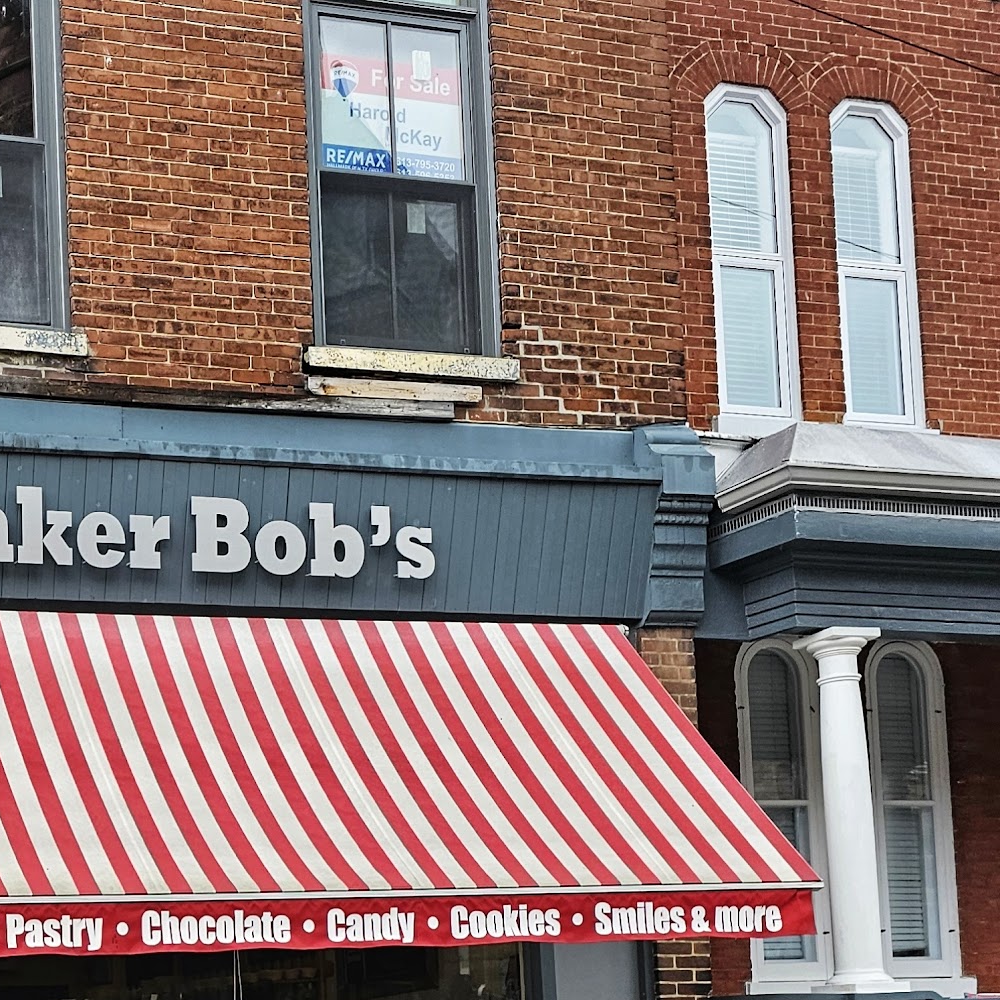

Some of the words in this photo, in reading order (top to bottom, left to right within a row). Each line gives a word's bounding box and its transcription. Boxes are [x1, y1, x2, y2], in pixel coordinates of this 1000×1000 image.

[349, 101, 406, 123] Harod
[326, 147, 386, 168] RE/MAX
[191, 496, 436, 579] Bob's
[5, 913, 103, 951] Pastry
[140, 909, 291, 946] Chocolate
[326, 907, 415, 944] Candy
[450, 904, 561, 939] Cookies
[594, 902, 686, 936] Smiles
[691, 908, 711, 933] &
[715, 904, 783, 933] more
